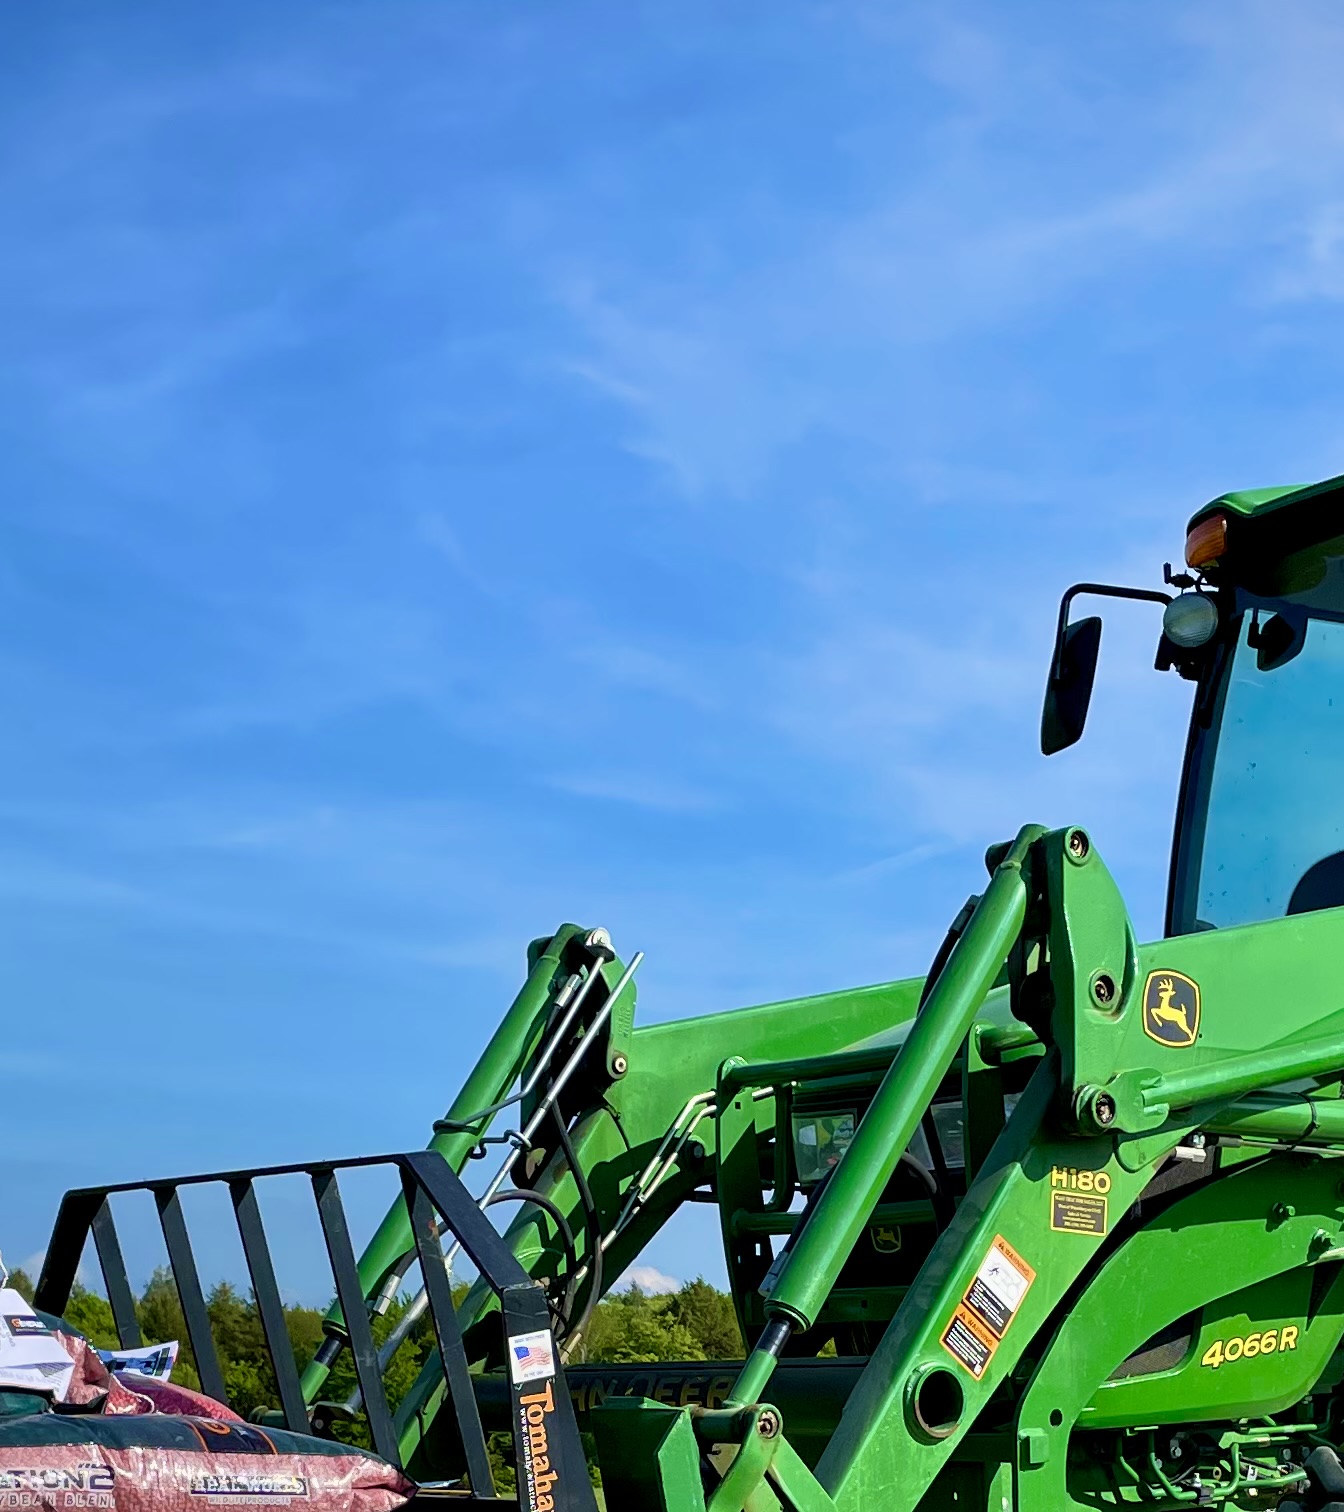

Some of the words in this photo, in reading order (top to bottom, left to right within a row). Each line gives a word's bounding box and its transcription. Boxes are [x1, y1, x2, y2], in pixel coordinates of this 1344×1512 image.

[967, 1319, 993, 1346] WARNING
[1201, 1325, 1298, 1369] 4066R
[625, 1374, 735, 1408] DEER
[64, 1493, 115, 1508] BLEN
